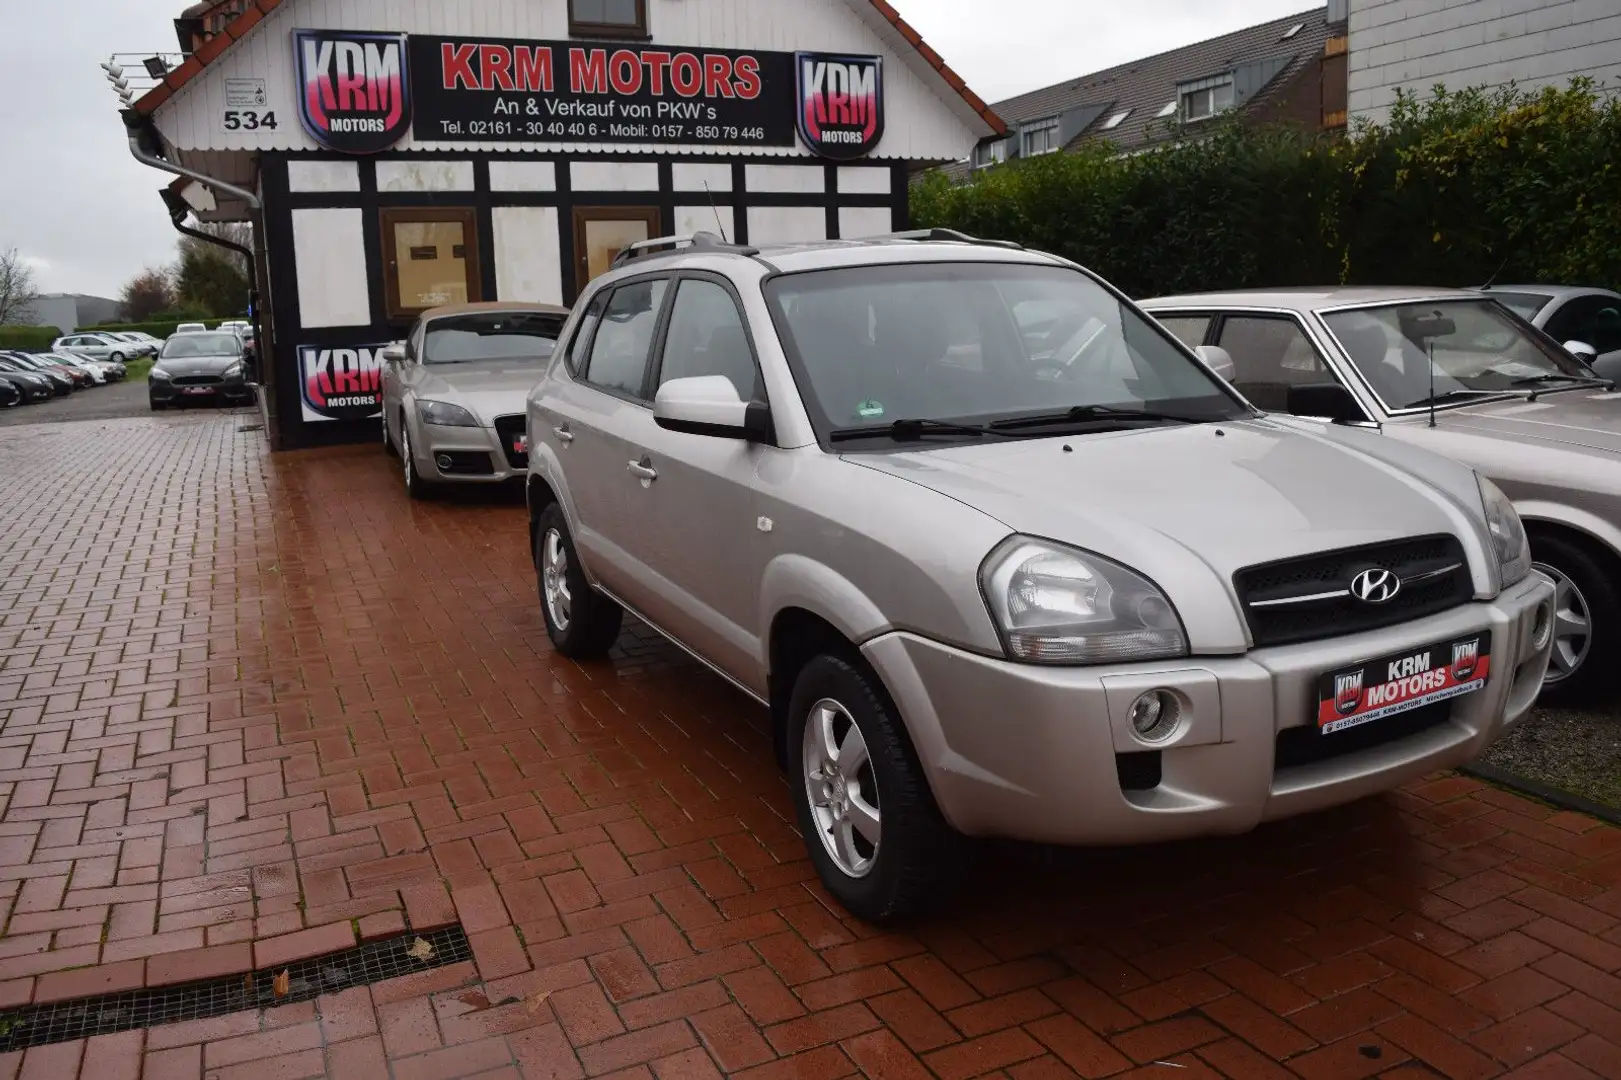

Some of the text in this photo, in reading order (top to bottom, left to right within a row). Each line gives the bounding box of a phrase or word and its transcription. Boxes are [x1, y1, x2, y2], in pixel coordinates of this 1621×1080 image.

[303, 40, 402, 112] KRM
[441, 43, 762, 100] KRM MOTORS
[804, 61, 876, 125] KRM
[493, 97, 520, 115] An
[525, 97, 540, 116] &
[544, 98, 616, 118] Verkauf
[619, 104, 651, 118] von
[224, 111, 278, 131] 534
[330, 118, 386, 133] MOTORS
[440, 120, 465, 135] Tel.
[469, 121, 512, 136] 02161
[526, 122, 544, 136] 30
[547, 122, 565, 136] 40
[567, 123, 586, 136] 40
[588, 123, 598, 137] 6
[610, 124, 649, 137] Mobil:
[652, 124, 684, 138] 0157
[695, 126, 720, 139] 850
[723, 126, 738, 139] 79
[741, 127, 765, 140] 446
[821, 130, 863, 144] MOTORS
[305, 348, 383, 393] KRM
[327, 395, 375, 408] MOTORS
[1388, 652, 1430, 681] KRM
[1367, 668, 1446, 706] MOTORS
